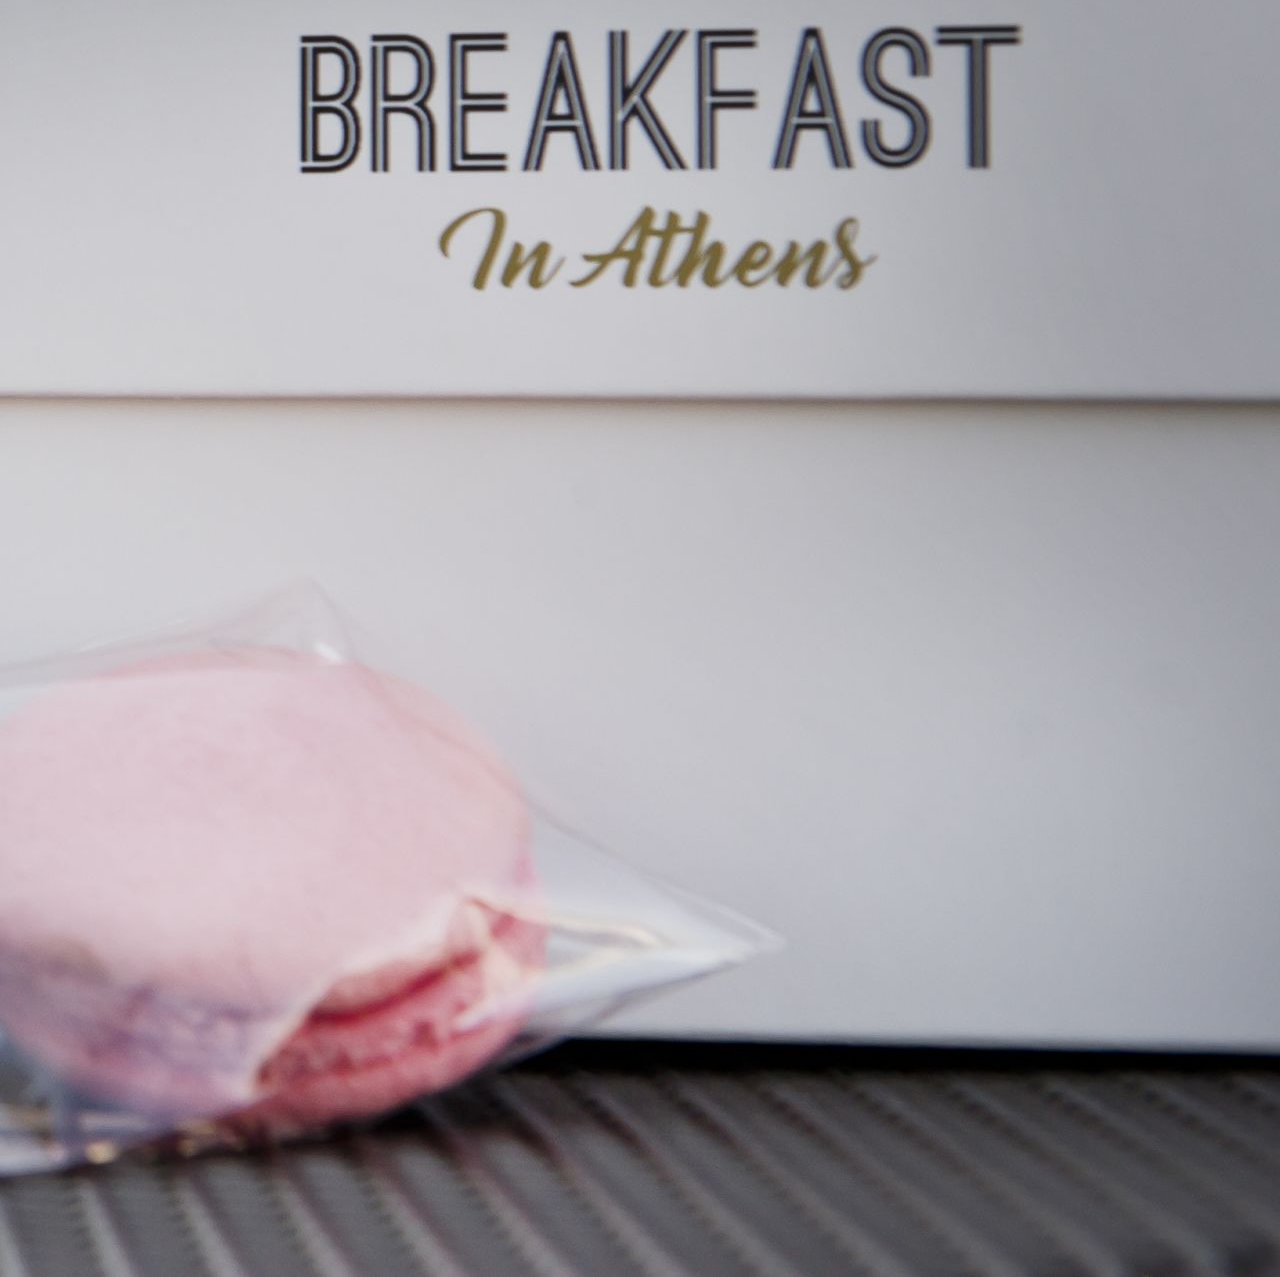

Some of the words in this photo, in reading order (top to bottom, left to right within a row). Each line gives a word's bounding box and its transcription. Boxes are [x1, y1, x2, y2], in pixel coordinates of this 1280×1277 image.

[298, 25, 1022, 175] BREAKFAST
[438, 206, 566, 292] In
[569, 206, 878, 291] Athens
